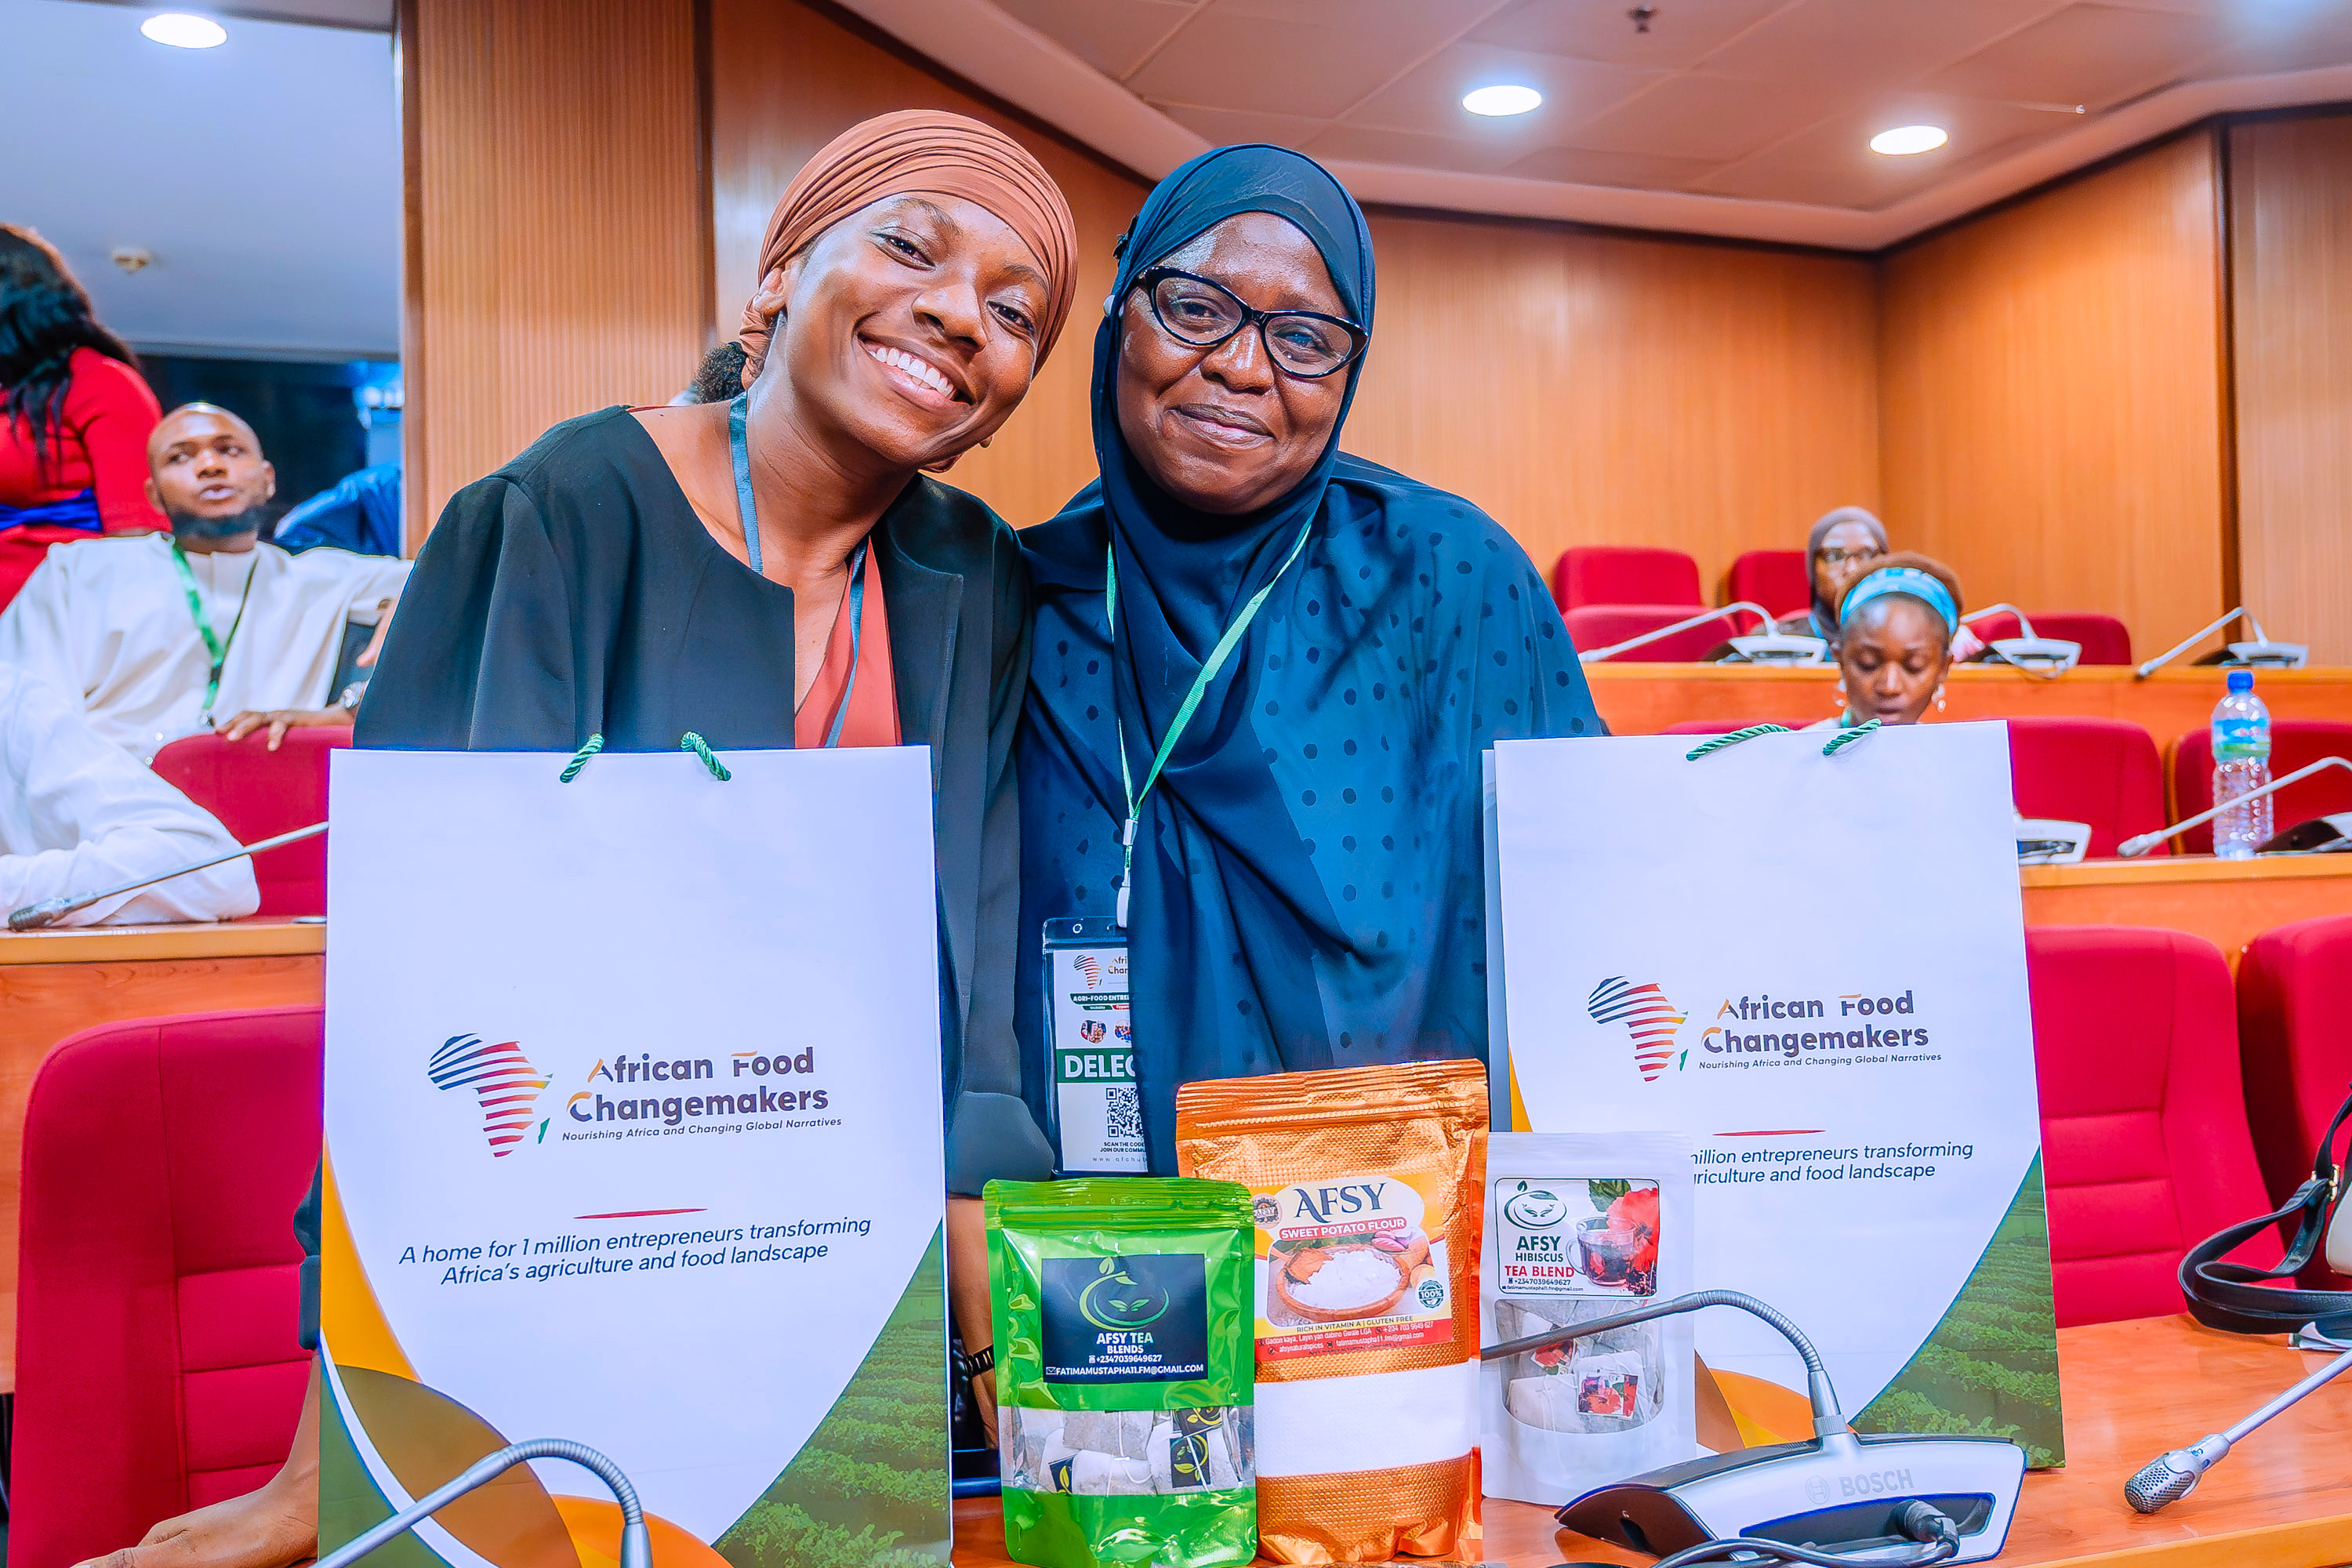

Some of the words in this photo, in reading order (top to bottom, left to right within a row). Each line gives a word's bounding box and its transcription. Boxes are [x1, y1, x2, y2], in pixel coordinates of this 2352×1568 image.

[1112, 956, 1127, 964] Afri
[1717, 994, 1824, 1020] African
[1838, 989, 1915, 1016] Food
[1700, 1023, 1929, 1058] Changemakers
[588, 1053, 713, 1083] African
[731, 1046, 815, 1077] Food
[1699, 1059, 1749, 1069] Nourishing
[1752, 1058, 1780, 1067] Africa
[1784, 1056, 1802, 1066] and
[1805, 1055, 1852, 1066] Changing
[1855, 1054, 1888, 1064] Global
[1891, 1052, 1942, 1062] Narratives
[566, 1085, 829, 1126] Changemakers
[562, 1130, 622, 1142] Nourishing
[626, 1127, 659, 1138] Africa
[663, 1125, 684, 1135] and
[688, 1123, 742, 1134] Changing
[746, 1120, 782, 1131] Global
[786, 1117, 842, 1129] Narratives
[1741, 1147, 1859, 1166] entrepreneurs
[1864, 1141, 1974, 1160] transforming
[1693, 1167, 1766, 1185] riculture
[1769, 1166, 1802, 1181] and
[1806, 1163, 1845, 1181] food
[1849, 1163, 1936, 1181] landscape
[1293, 1181, 1388, 1223] AFSY
[1281, 1228, 1319, 1239] SWEET
[1321, 1223, 1366, 1236] POTATO
[1368, 1218, 1406, 1231] FLOUR
[398, 1246, 416, 1265] A
[422, 1245, 483, 1263] home
[488, 1240, 517, 1258] for
[522, 1238, 530, 1256] 1
[534, 1235, 601, 1255] million
[606, 1226, 744, 1250] entrepreneurs
[750, 1216, 872, 1240] transforming
[1516, 1236, 1562, 1251] AFSY
[525, 1256, 633, 1282] agriculture
[638, 1250, 677, 1271] and
[681, 1247, 727, 1268] food
[731, 1243, 829, 1265] landscape
[1515, 1252, 1564, 1262] HIBISCUS
[1504, 1265, 1528, 1276] TEA
[1532, 1265, 1575, 1278] BLEND
[1421, 1290, 1443, 1298] 100%
[1096, 1333, 1127, 1345] AFSY
[1130, 1332, 1154, 1344] TEA
[1096, 1354, 1162, 1363] +2347039649627
[1106, 1345, 1144, 1354] BLENDS
[1055, 1364, 1204, 1375] FATIMAMUSTAPHA11.FM@GMAIL.COM
[1838, 1468, 1915, 1497] BOSCH
